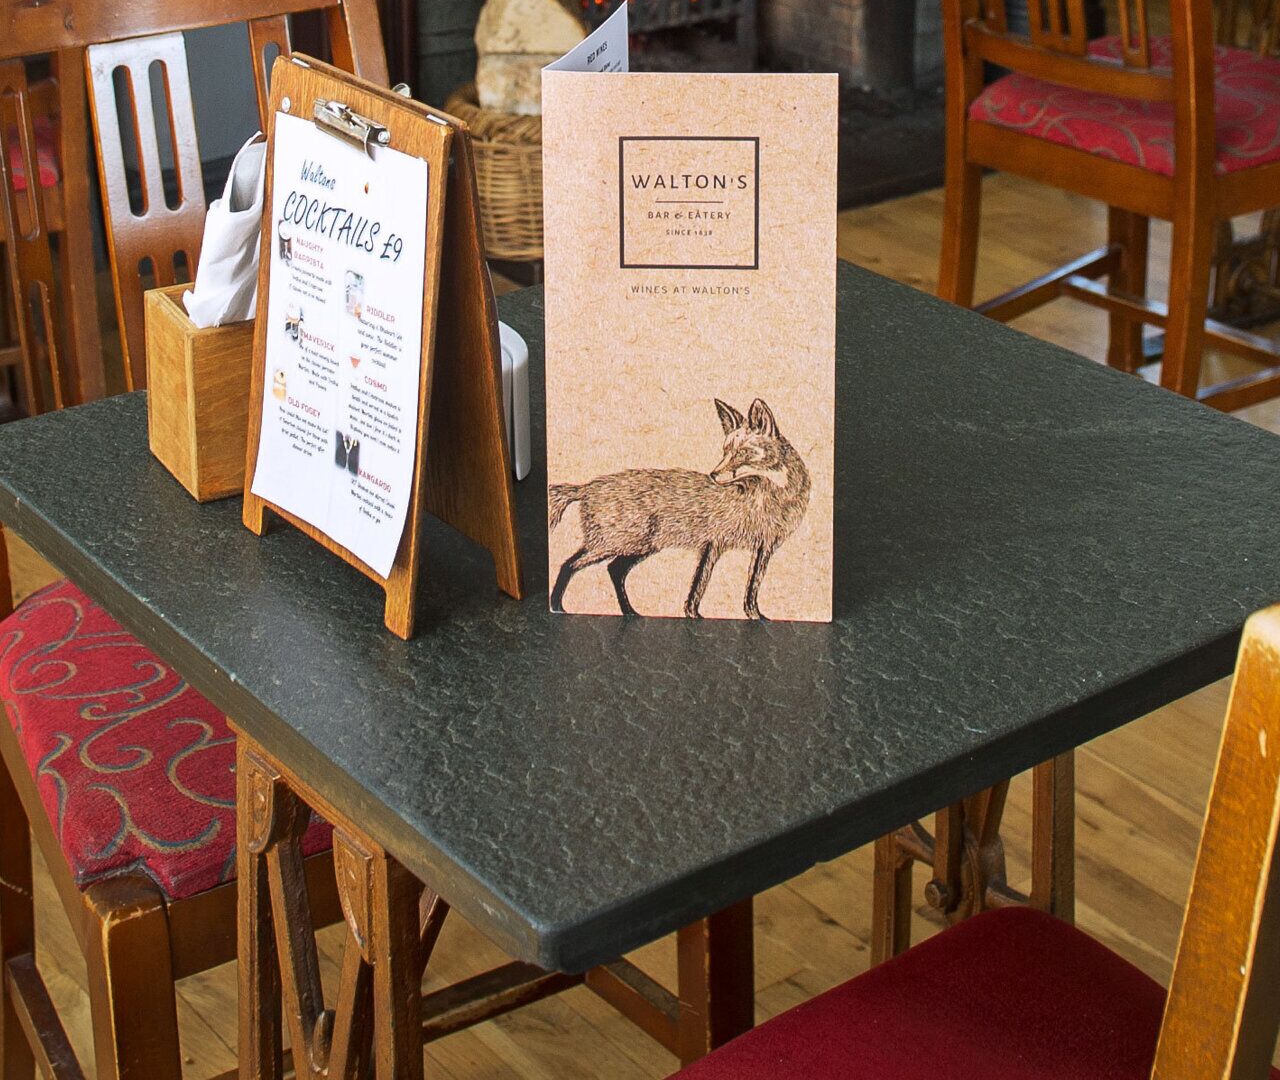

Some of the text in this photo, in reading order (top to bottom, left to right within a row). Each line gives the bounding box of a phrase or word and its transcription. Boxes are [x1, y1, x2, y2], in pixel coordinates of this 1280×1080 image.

[631, 174, 747, 189] WALTON'S
[647, 211, 670, 220] BAR
[674, 211, 684, 220] &
[283, 191, 403, 262] COCKTAILS £9
[296, 236, 324, 252] NAUGHTY
[631, 286, 751, 296] WINES AT WALTON'S
[366, 304, 396, 323] RIDDLER
[303, 332, 336, 353] MAVERICK
[364, 375, 388, 393] COSMO
[287, 396, 300, 409] OLD
[358, 468, 392, 493] KANGAROO
